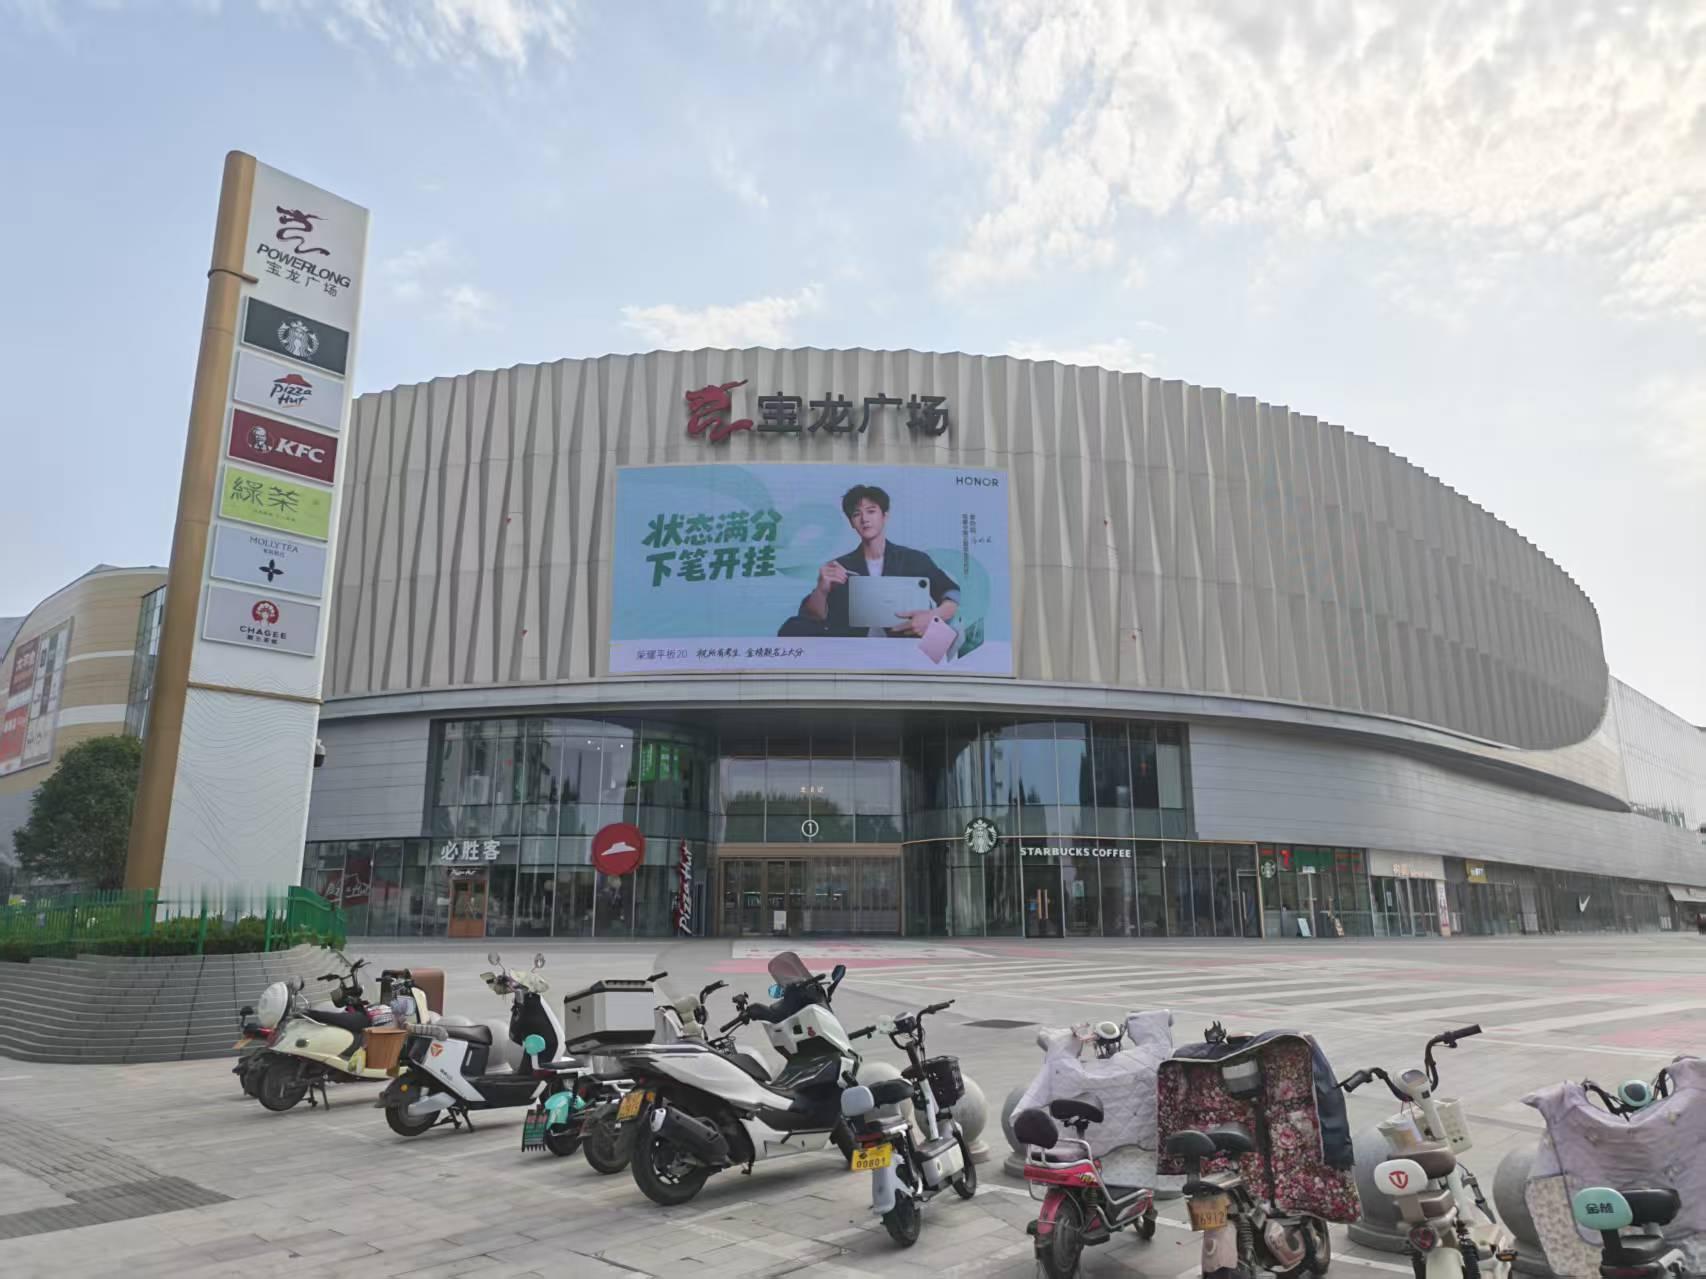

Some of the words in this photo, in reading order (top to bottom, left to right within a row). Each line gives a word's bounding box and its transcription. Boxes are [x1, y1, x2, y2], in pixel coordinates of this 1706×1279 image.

[256, 243, 351, 288] POWERLONG
[265, 260, 337, 297] 宝龙广场
[270, 383, 313, 398] Pizza
[278, 393, 306, 405] Hut
[757, 391, 950, 436] 宝龙广场
[275, 437, 325, 463] KFC
[956, 475, 999, 488] HONOR
[641, 507, 783, 548] 状态满分
[645, 544, 776, 587] 下笔开挂
[239, 625, 287, 640] CHAGEE
[440, 840, 501, 861] 必胜客
[1019, 847, 1090, 857] STARBUCKS
[1092, 848, 1132, 858] COFFEE
[678, 882, 692, 934] Pizza
